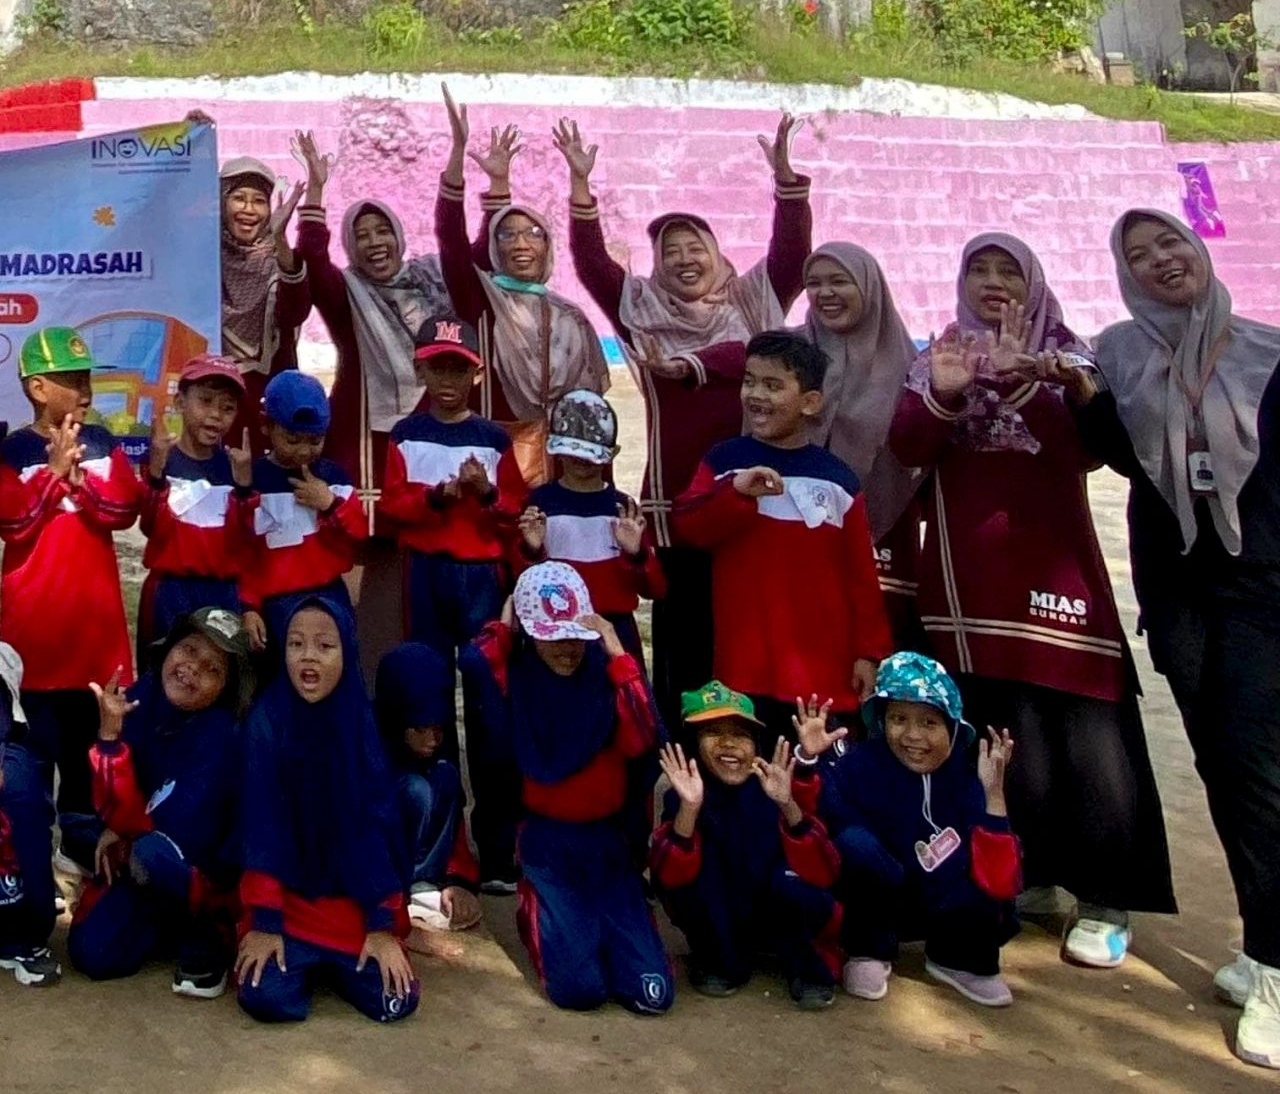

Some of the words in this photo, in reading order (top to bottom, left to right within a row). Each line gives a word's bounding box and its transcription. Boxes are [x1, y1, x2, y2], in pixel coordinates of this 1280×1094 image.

[91, 135, 191, 159] INOVASI
[0, 251, 143, 276] MADRASAH
[1030, 590, 1087, 616] MIAS
